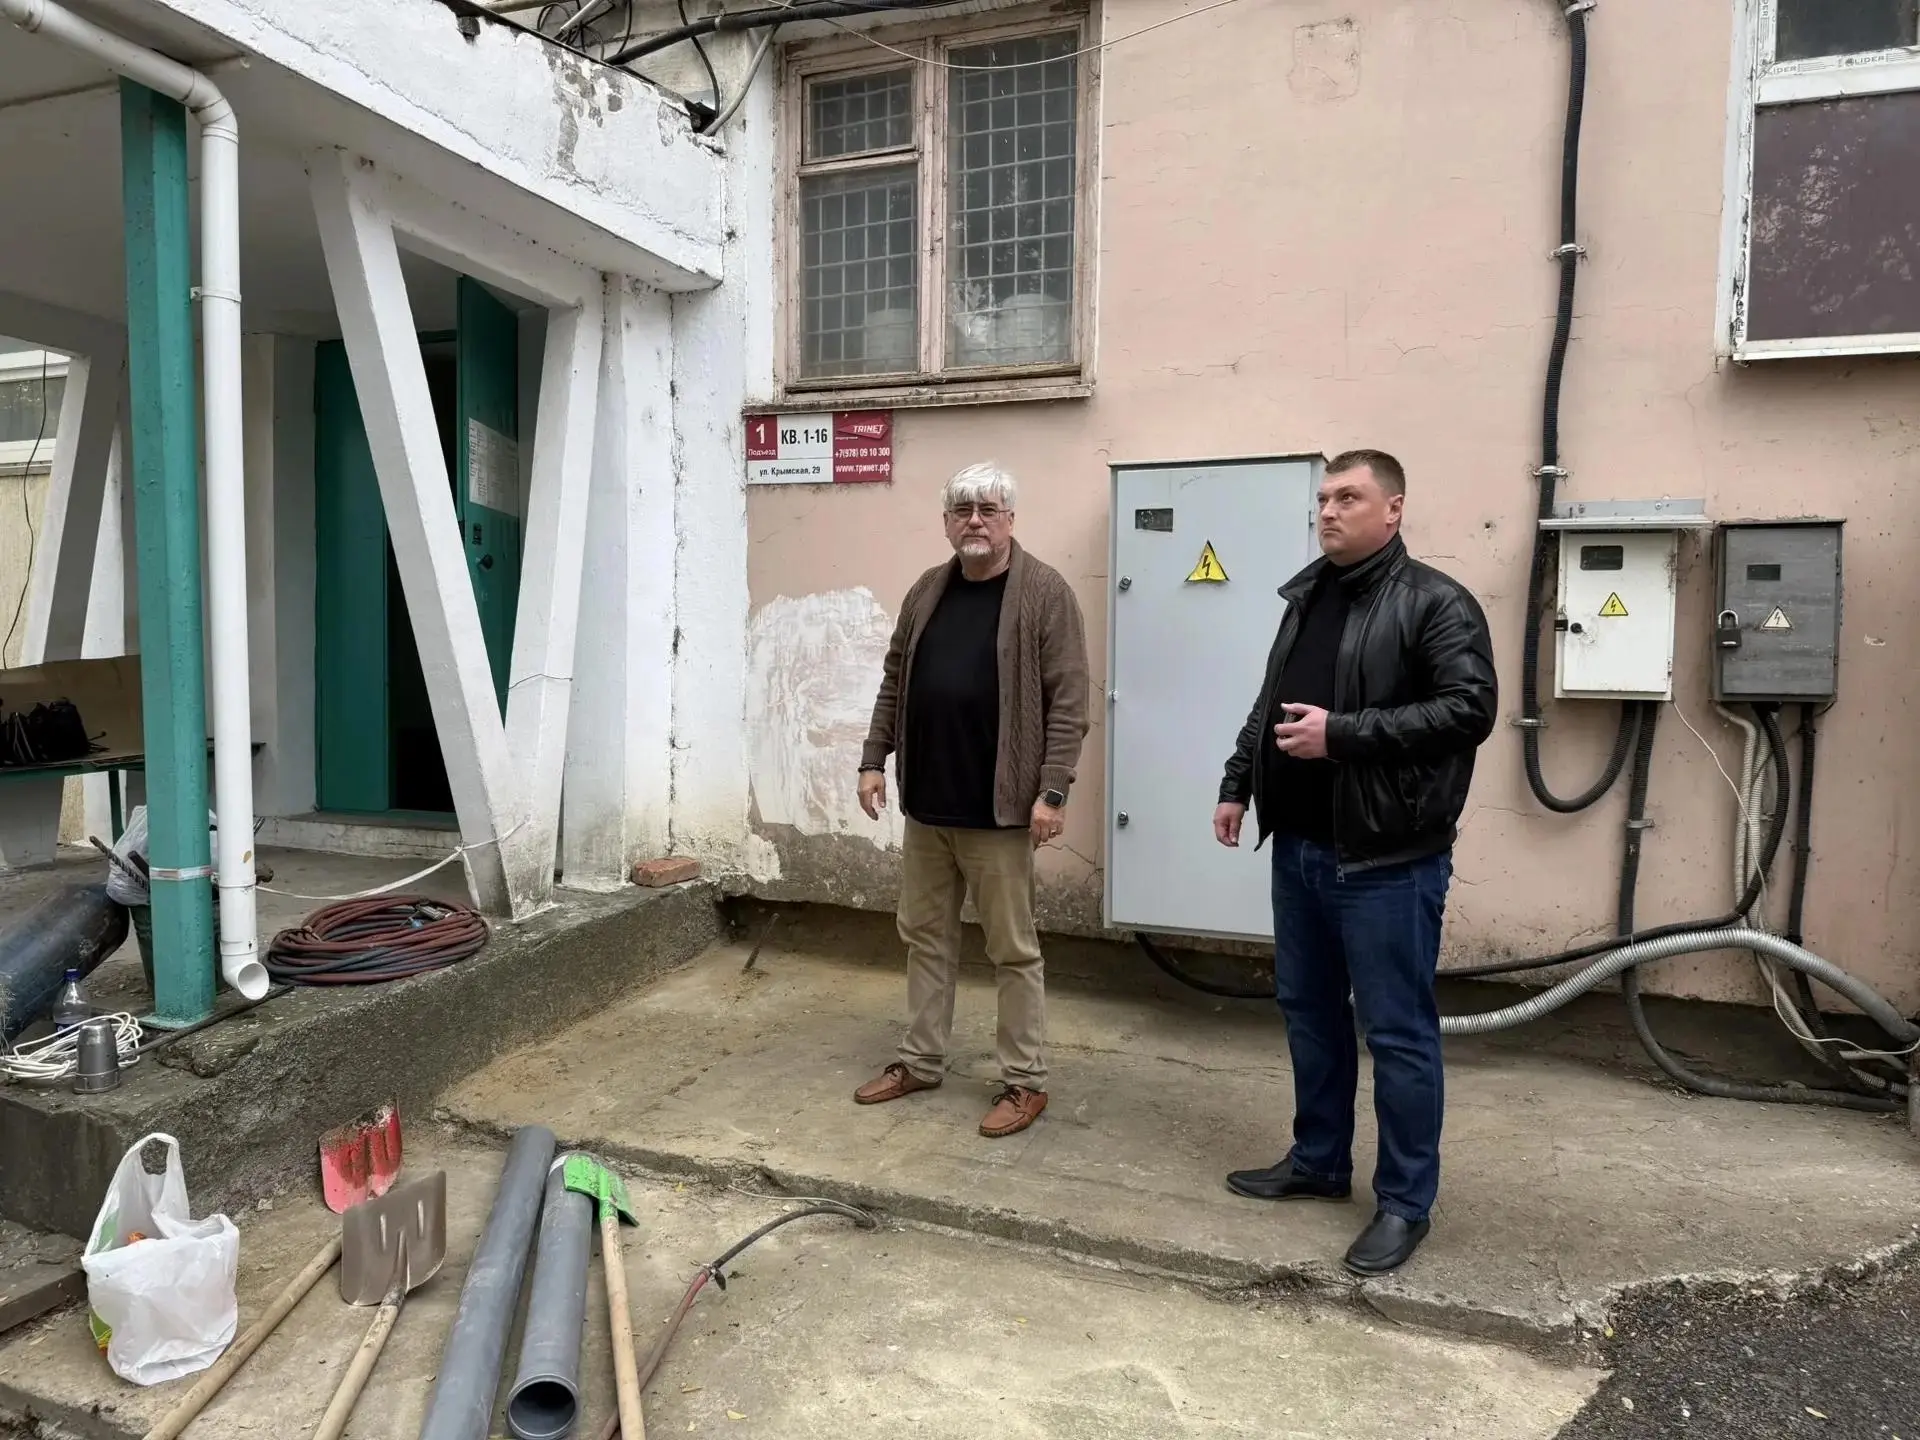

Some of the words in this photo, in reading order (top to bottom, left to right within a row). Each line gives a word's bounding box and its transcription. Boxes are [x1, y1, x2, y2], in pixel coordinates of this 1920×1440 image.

[756, 423, 765, 444] 1
[853, 424, 884, 433] TRINET
[781, 429, 801, 445] КВ.
[803, 428, 828, 444] 1-16
[870, 448, 877, 456] 10
[759, 469, 769, 477] ул.
[771, 467, 811, 477] Крымская,
[812, 466, 821, 474] 29
[835, 462, 890, 475] www.тринет.рф
